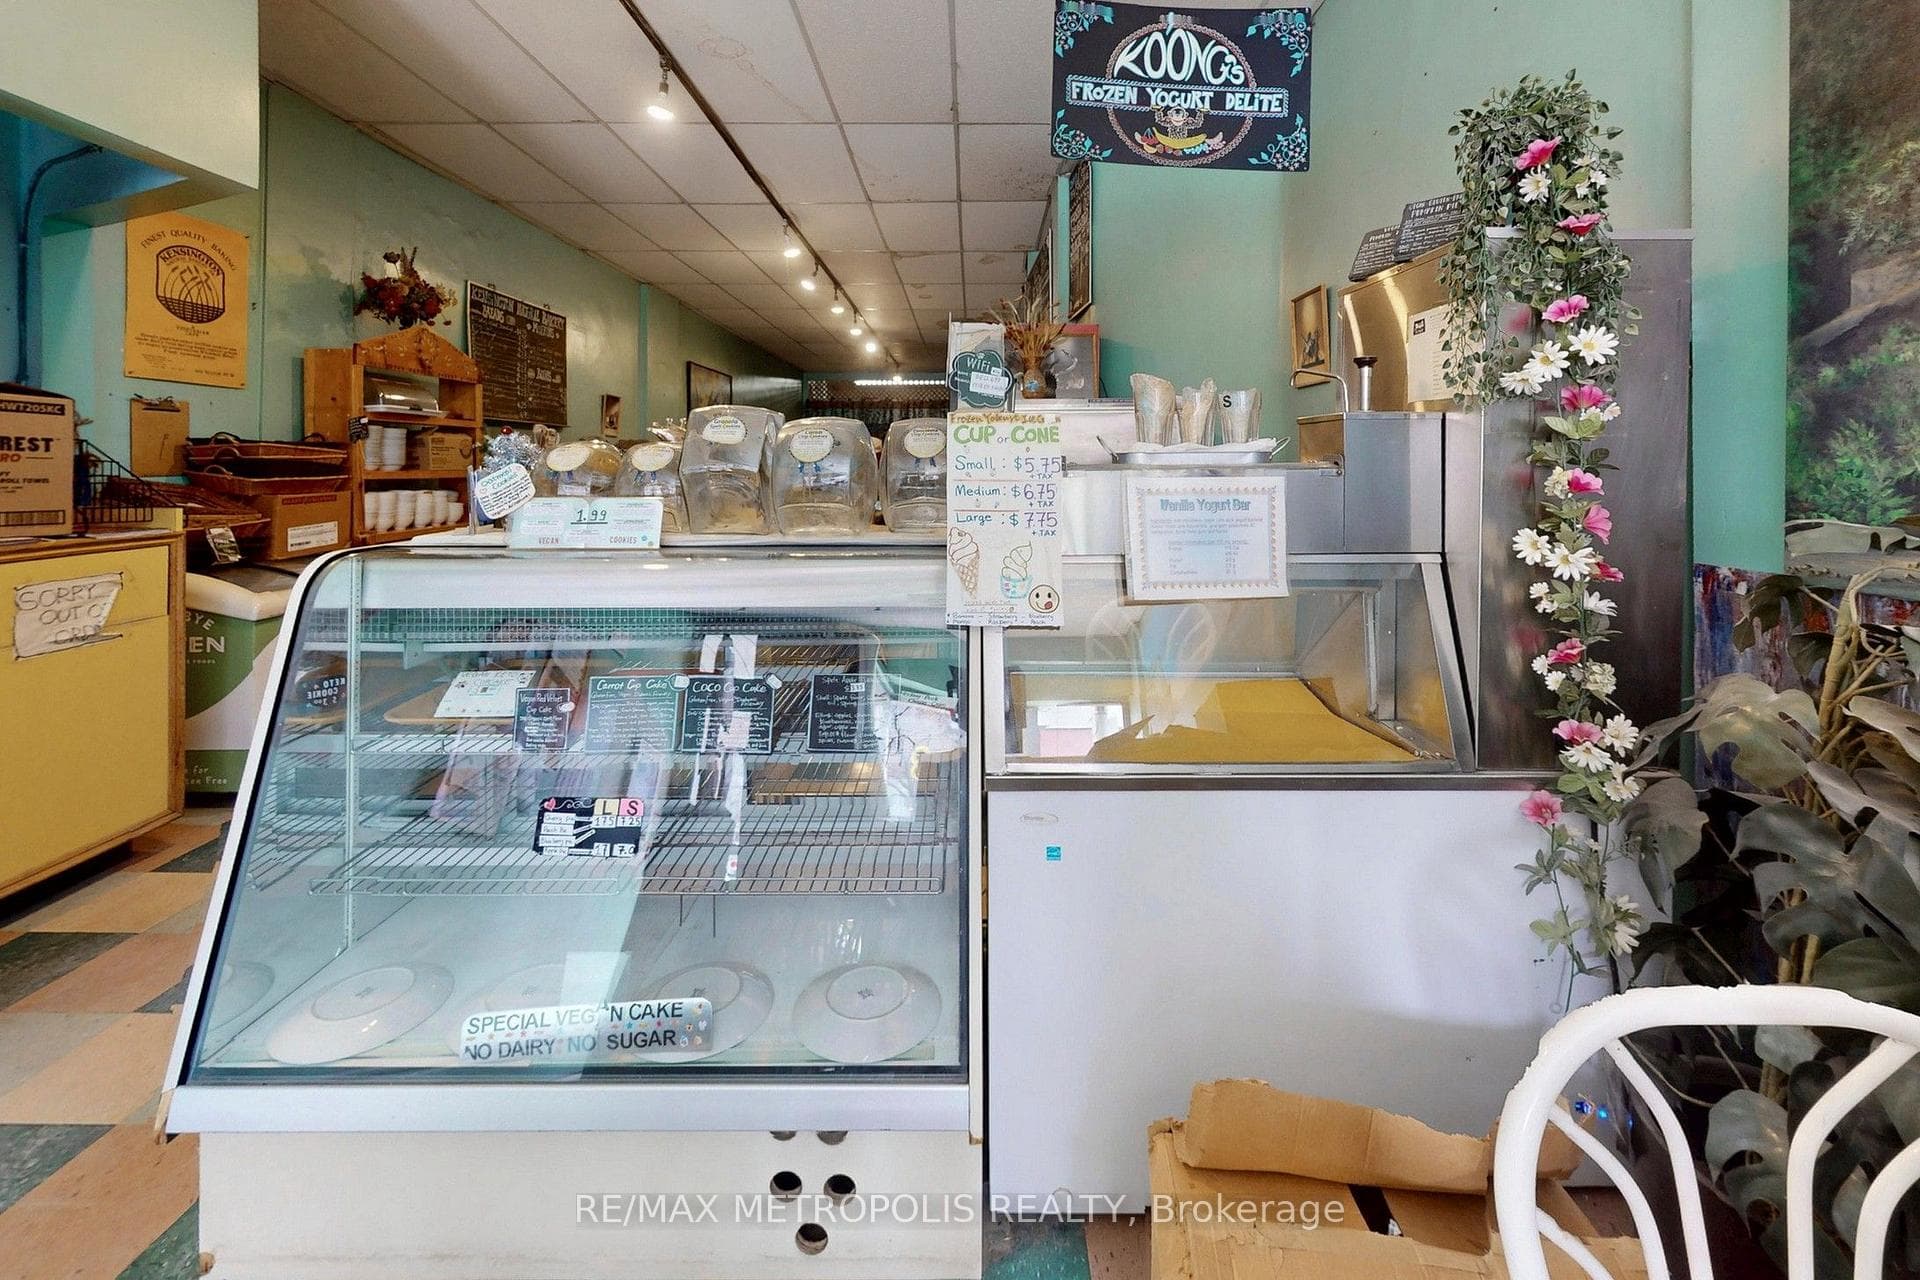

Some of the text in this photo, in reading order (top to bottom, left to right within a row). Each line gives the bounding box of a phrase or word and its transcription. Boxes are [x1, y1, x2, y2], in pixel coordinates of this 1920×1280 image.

[1145, 87, 1214, 110] YOGURT
[140, 230, 166, 248] FINEST
[170, 229, 206, 243] QUALITY
[160, 247, 220, 277] KENSINGTON
[1223, 395, 1232, 408] S
[953, 425, 996, 444] CUP
[1011, 426, 1060, 444] CONE
[1037, 500, 1054, 508] TAX
[1160, 498, 1251, 513] Vanilla Yogurt Bar
[576, 509, 608, 522] 1.99
[538, 536, 638, 545] VEGAN COOKIES
[1040, 529, 1057, 537] TAX
[40, 604, 83, 625] OUT
[596, 679, 624, 690] Carrot
[742, 682, 767, 693] Cake
[602, 800, 638, 816] L S
[467, 1013, 551, 1034] SPECIAL
[628, 1001, 684, 1021] CAKE
[465, 1030, 677, 1061] NO DAIRY NO SUGAR
